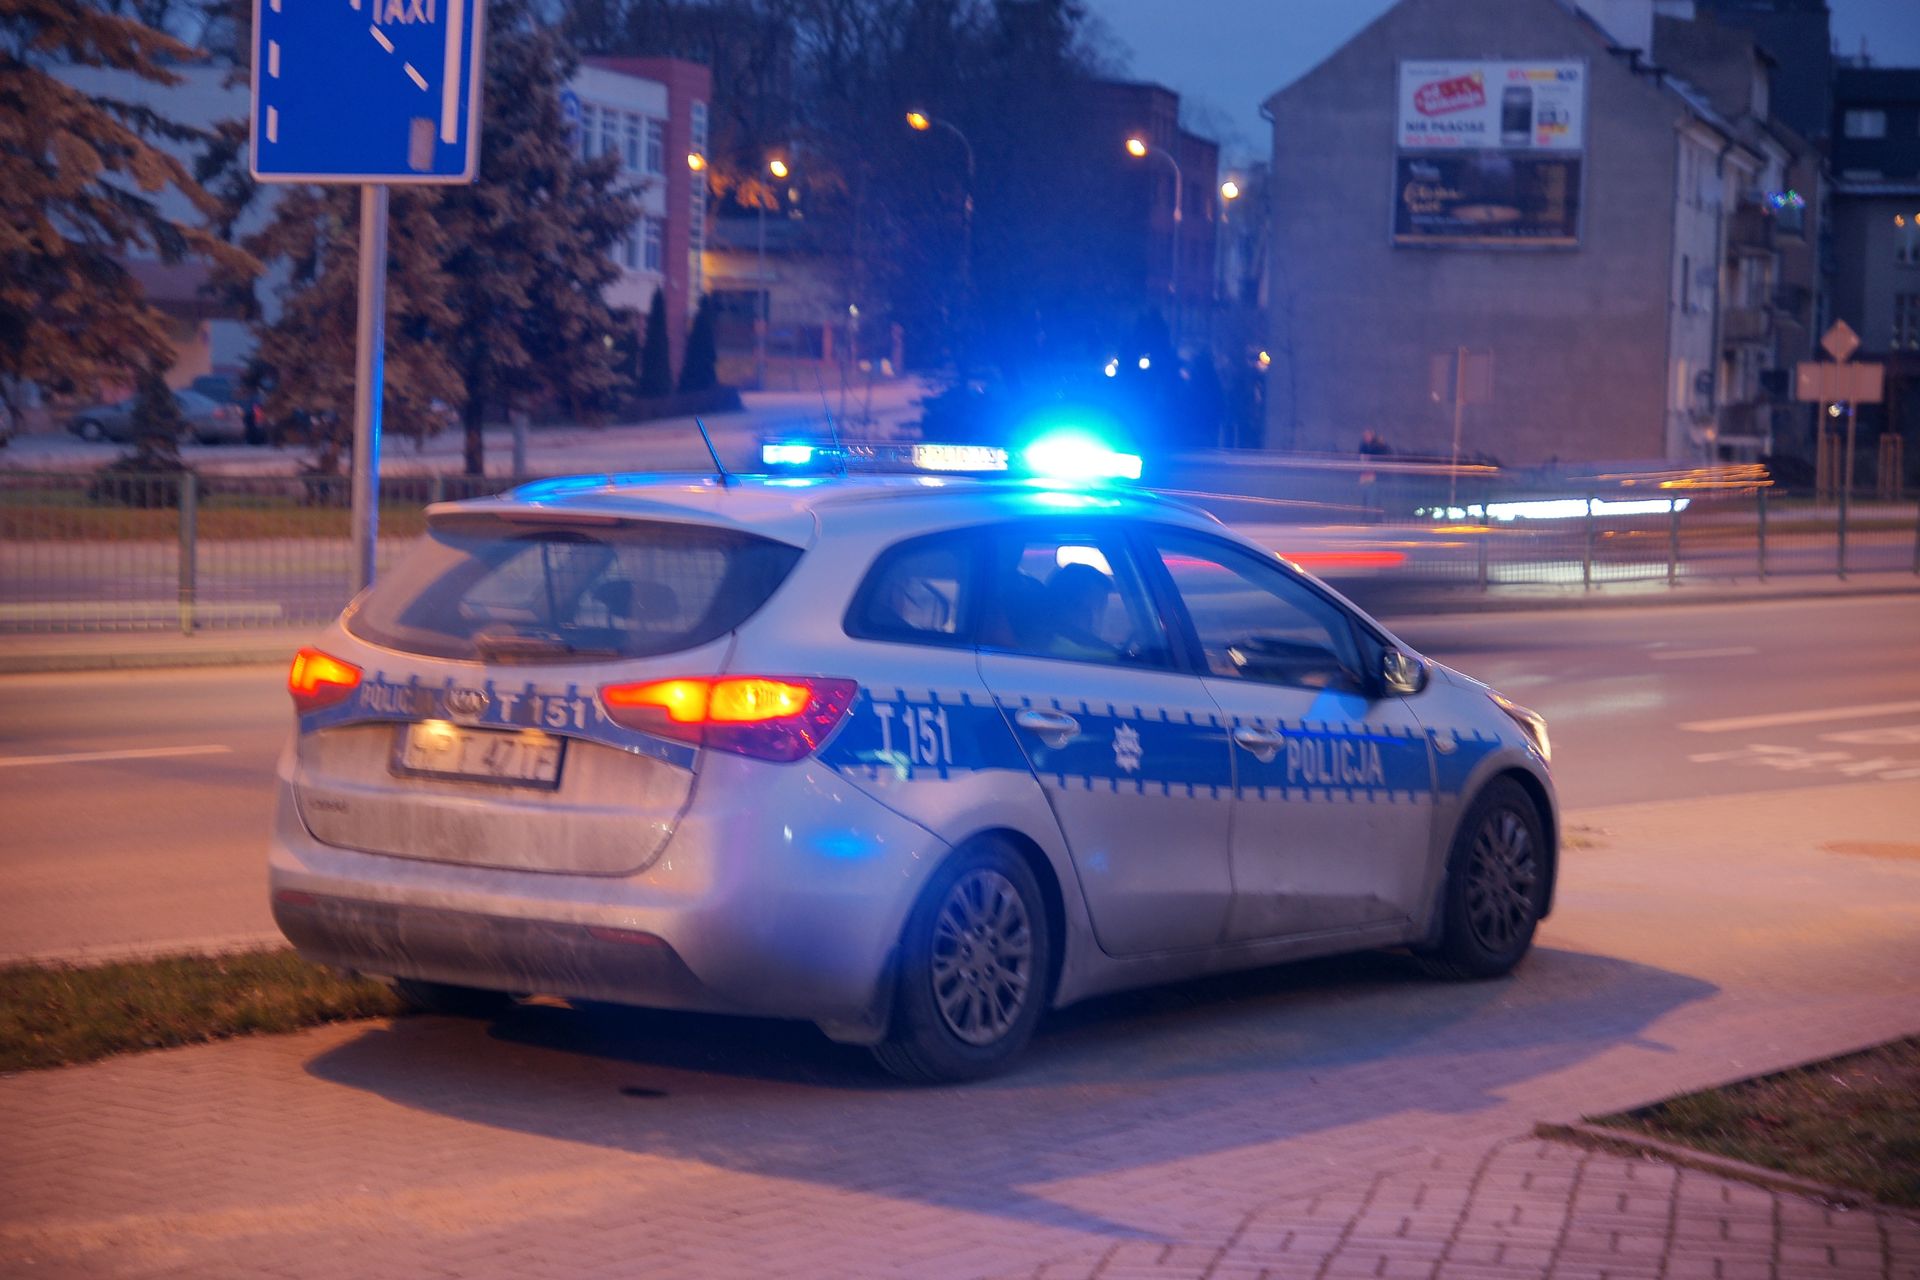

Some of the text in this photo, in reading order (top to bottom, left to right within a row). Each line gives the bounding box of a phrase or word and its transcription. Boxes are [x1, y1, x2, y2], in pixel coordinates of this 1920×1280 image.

[496, 694, 519, 722] T
[528, 695, 586, 729] 151
[872, 702, 953, 766] T 151
[1286, 737, 1385, 786] POLICJA
